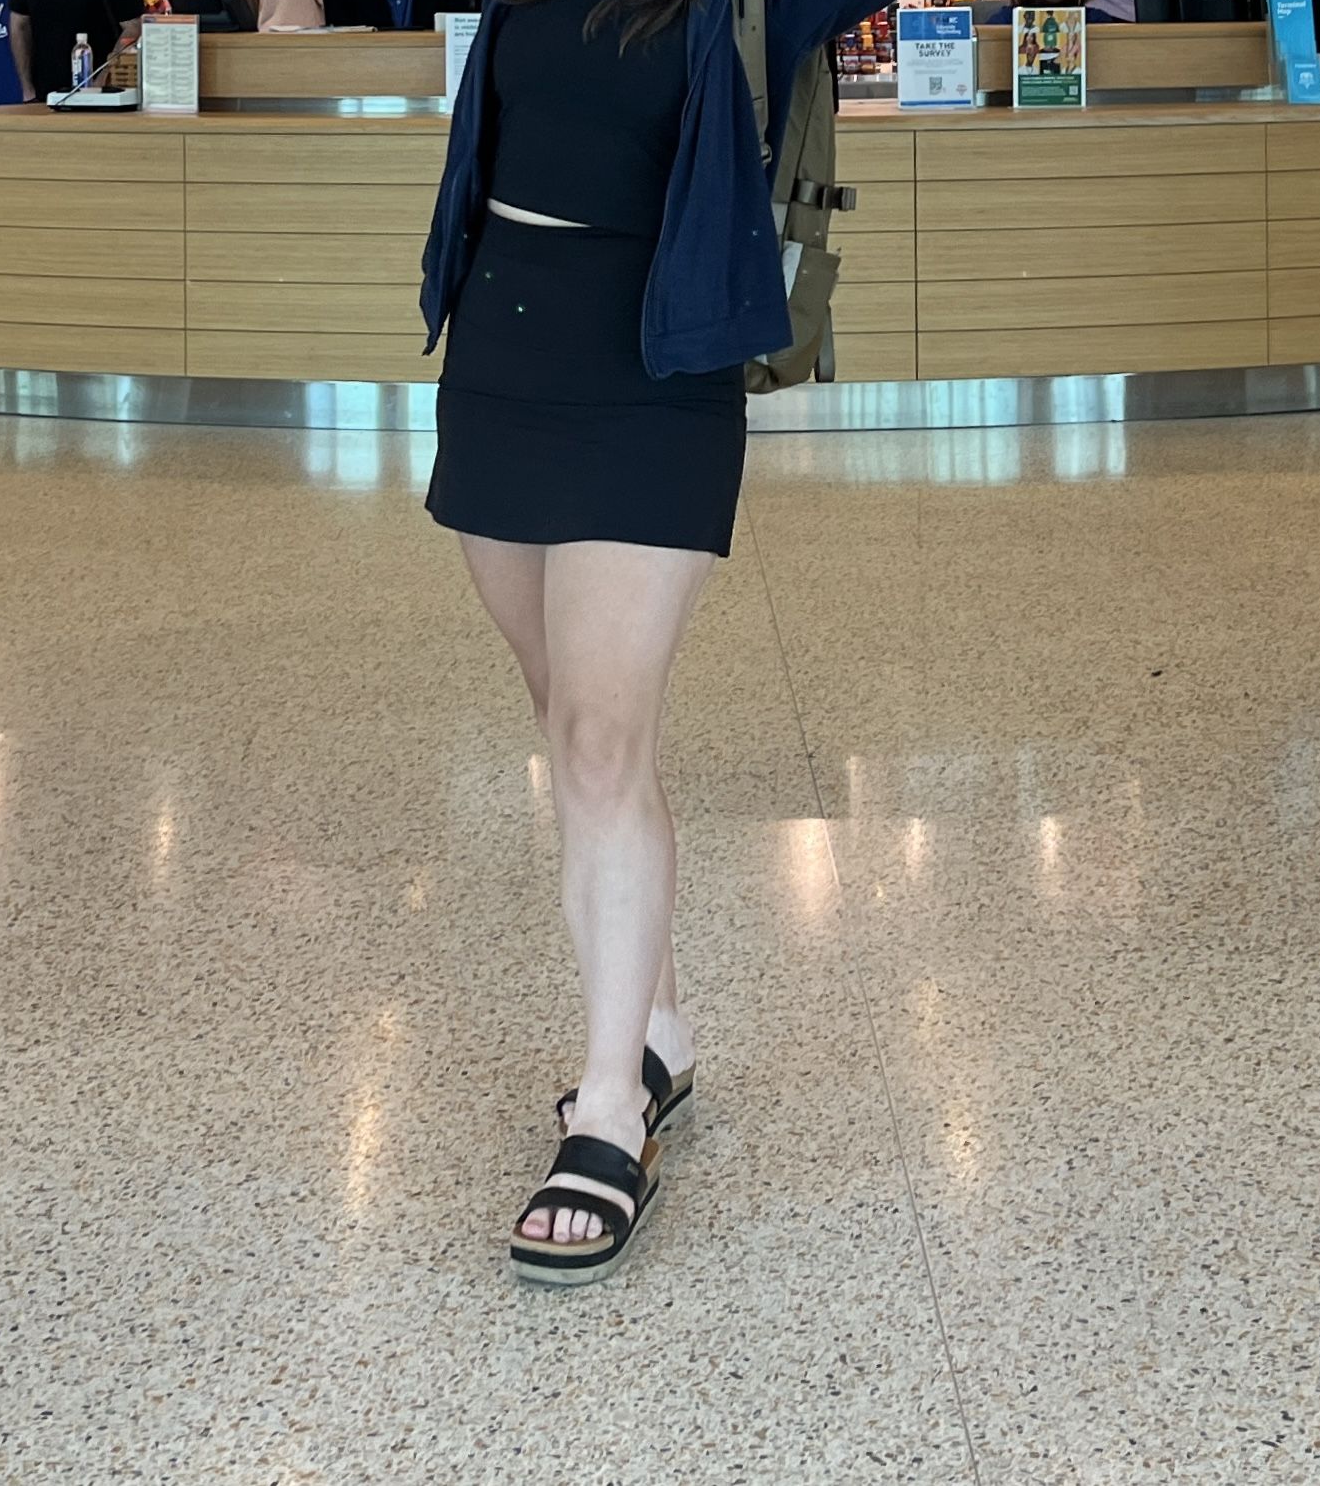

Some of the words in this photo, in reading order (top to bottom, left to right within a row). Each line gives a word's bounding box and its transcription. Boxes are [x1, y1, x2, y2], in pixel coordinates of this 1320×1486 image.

[915, 42, 935, 50] TAKE
[938, 42, 955, 50] THE
[918, 50, 951, 58] SURVEY
